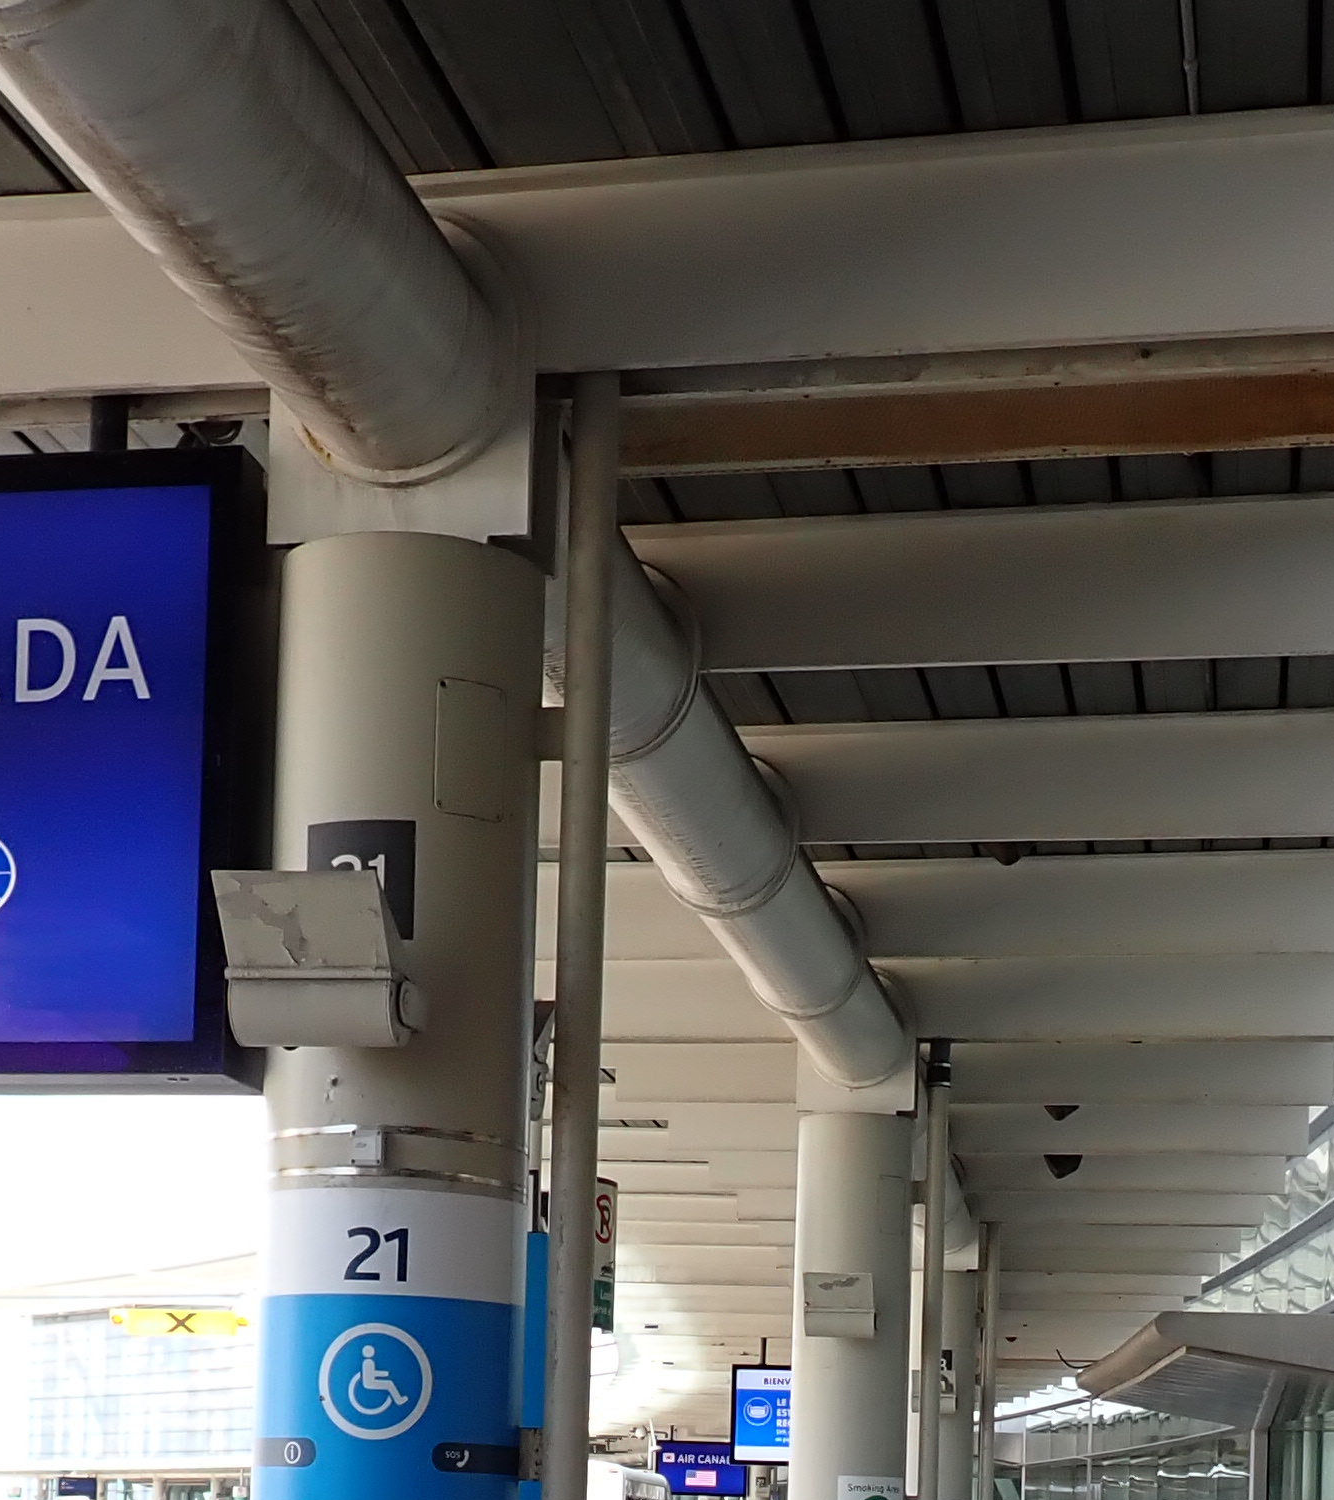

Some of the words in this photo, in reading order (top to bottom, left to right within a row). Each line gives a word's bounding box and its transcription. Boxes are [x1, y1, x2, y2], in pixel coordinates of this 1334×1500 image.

[343, 1226, 409, 1282] 21
[444, 1450, 461, 1459] SOS
[677, 1453, 696, 1465] AIR
[847, 1482, 885, 1495] Smoking
